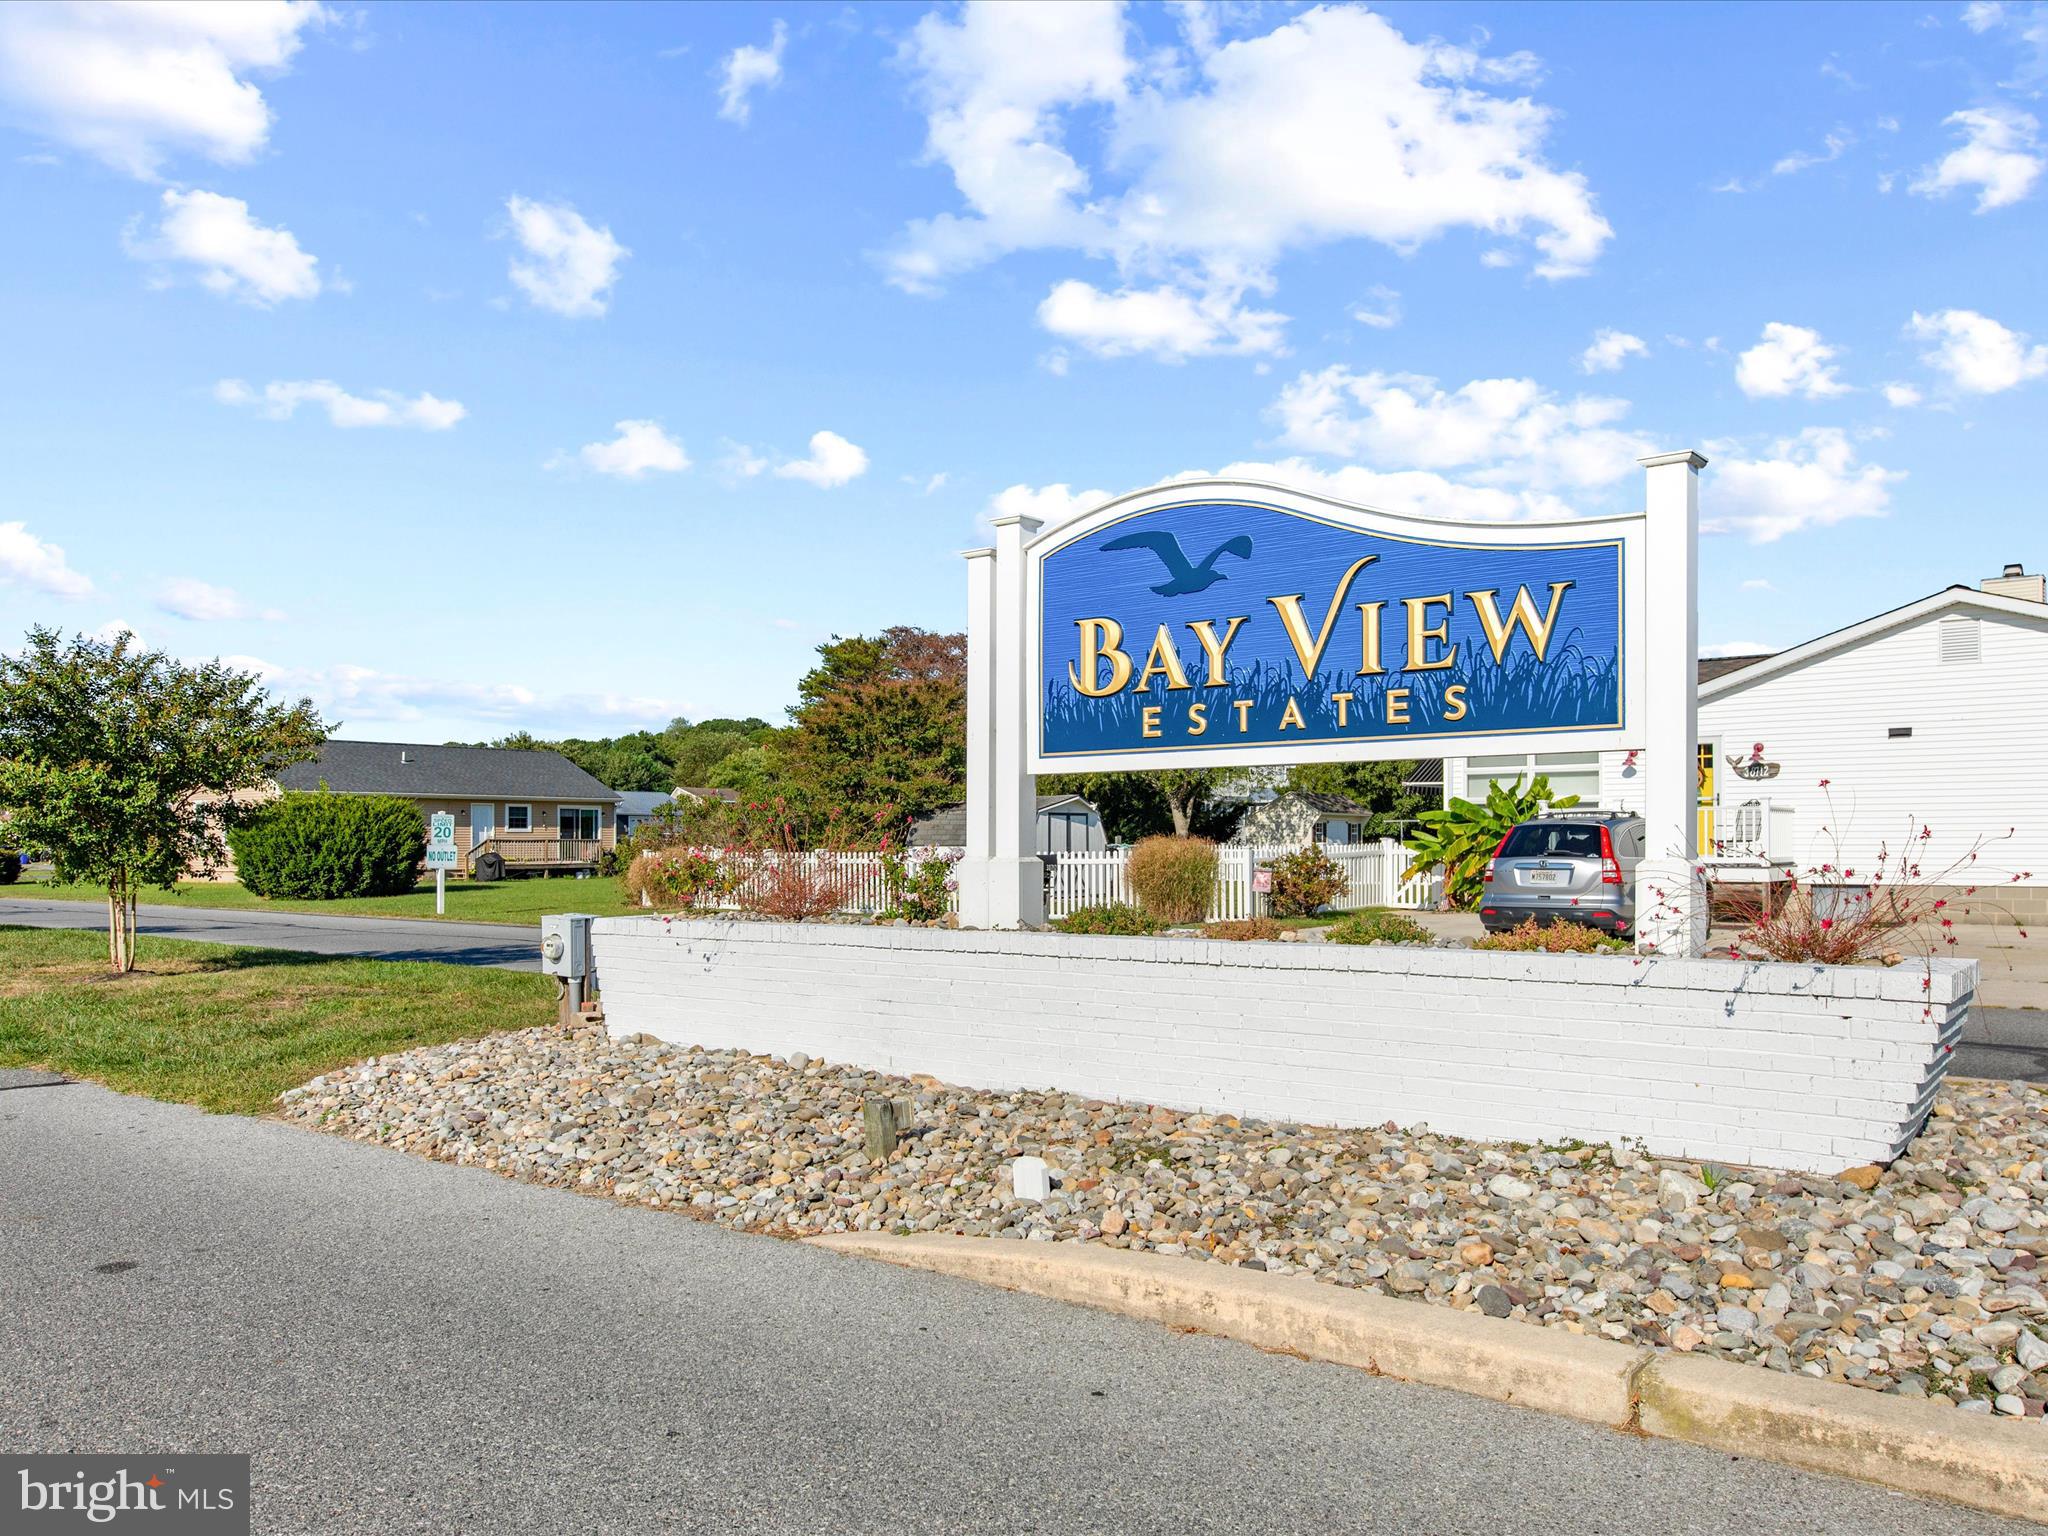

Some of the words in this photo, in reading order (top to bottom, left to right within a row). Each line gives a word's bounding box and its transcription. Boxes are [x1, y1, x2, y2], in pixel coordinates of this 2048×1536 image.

[1069, 616, 1250, 699] BAY
[1266, 554, 1575, 682] VIEW
[1142, 684, 1468, 739] ESTATES
[434, 826, 451, 838] 20
[428, 851, 436, 861] NO
[437, 851, 456, 861] OUTLET
